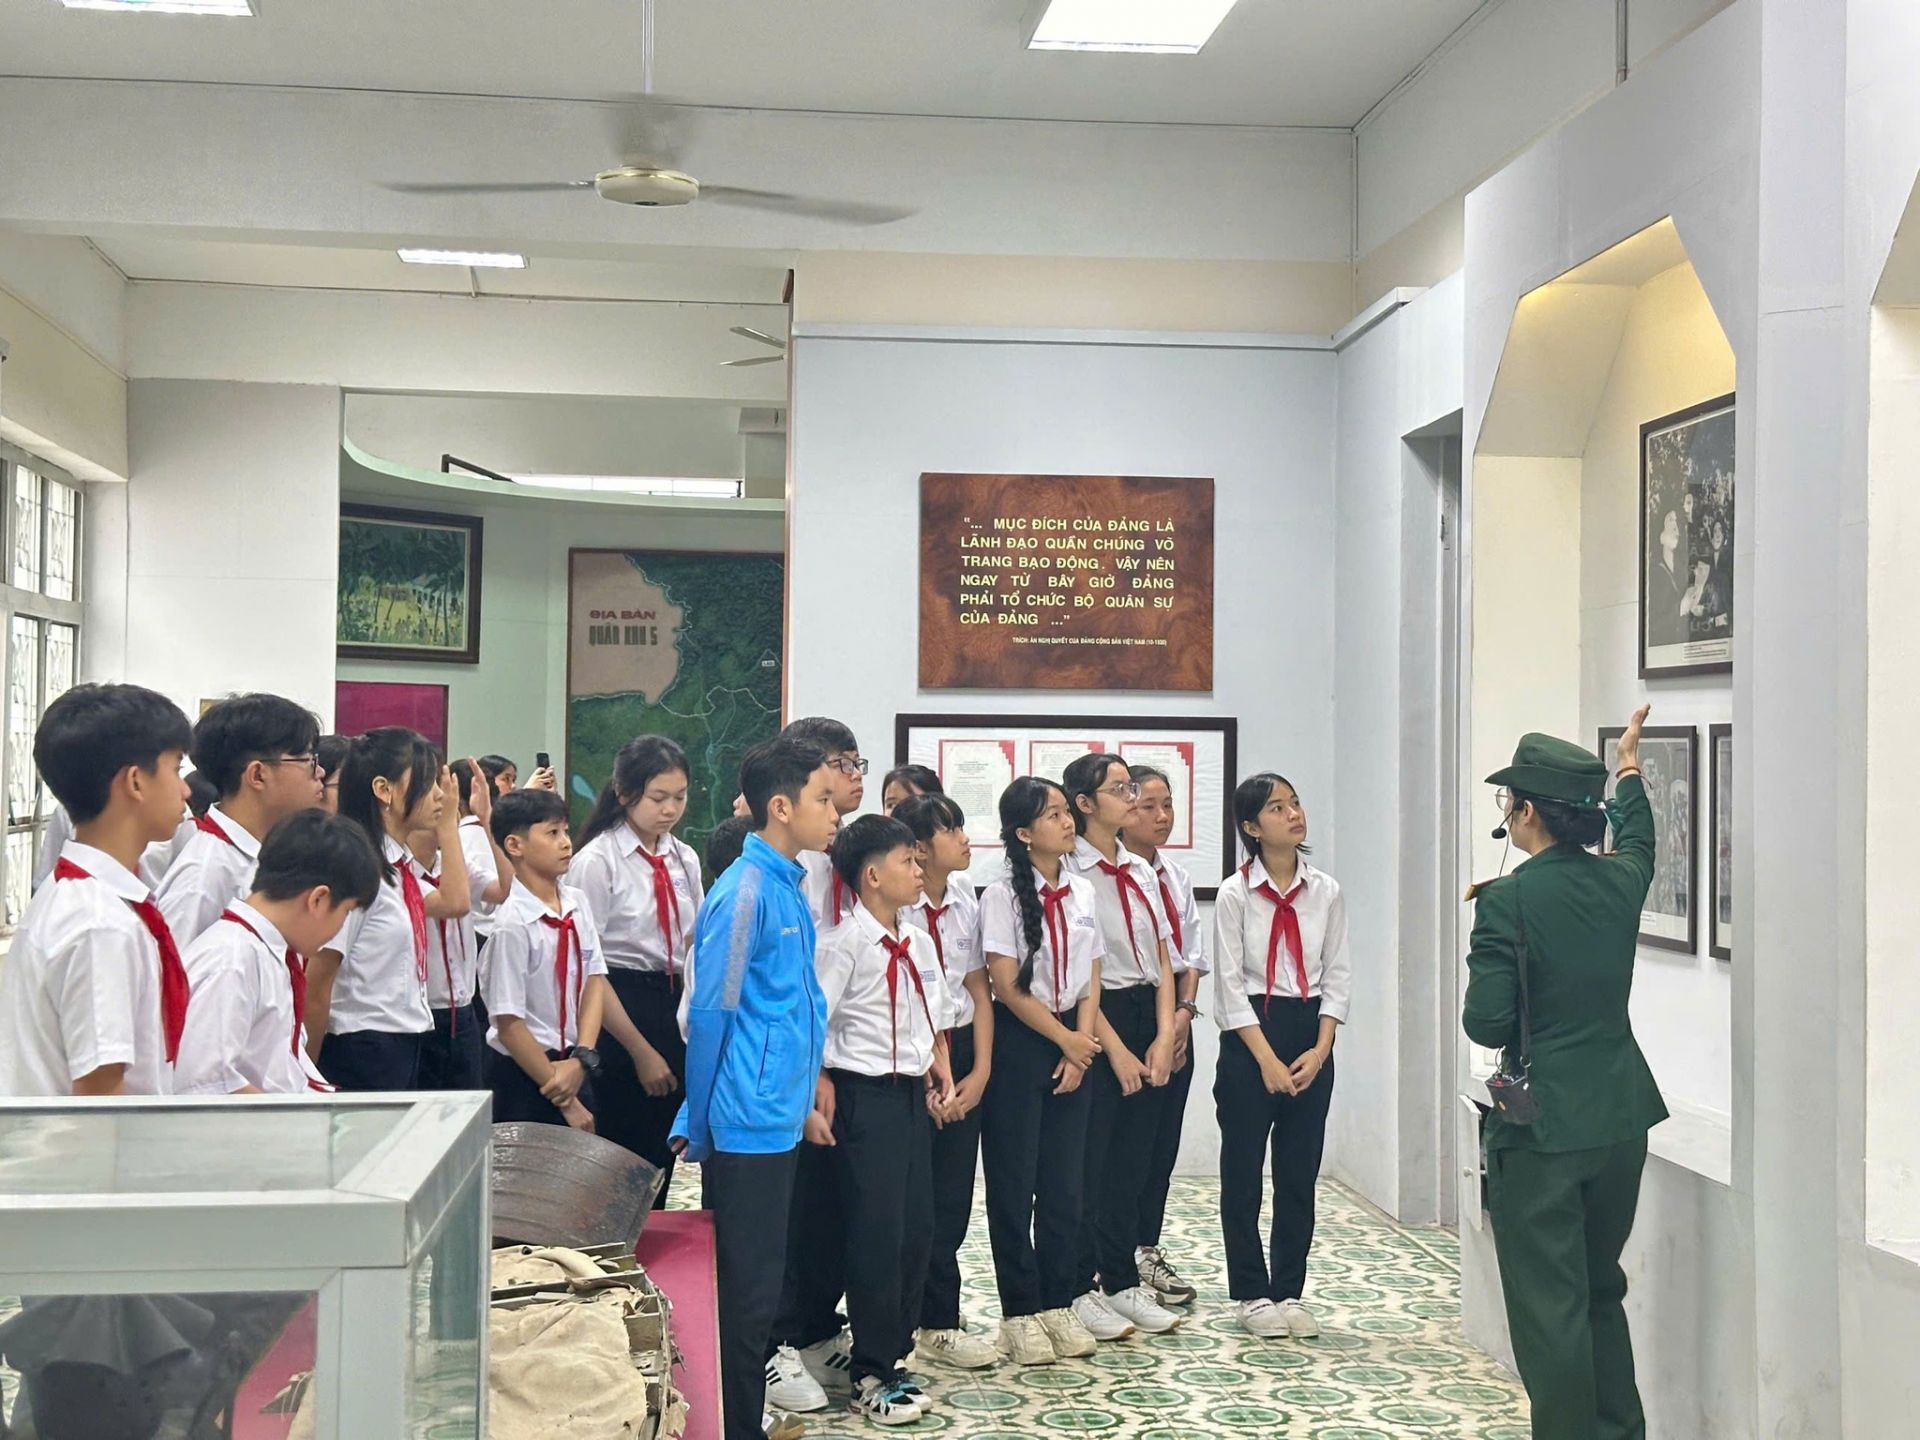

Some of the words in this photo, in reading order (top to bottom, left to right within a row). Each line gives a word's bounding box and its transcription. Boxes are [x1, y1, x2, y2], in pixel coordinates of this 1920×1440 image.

[993, 518, 1027, 532] MỤC
[1032, 516, 1067, 530] ĐÍCH
[1072, 516, 1103, 531] CỦA
[1107, 516, 1150, 532] ĐẢNG
[1156, 517, 1175, 532] LÀ
[960, 533, 1001, 548] LÃNH
[1006, 537, 1039, 550] ĐẠO
[1093, 536, 1145, 550] CHÚNG
[1154, 537, 1175, 551] VÕ
[961, 555, 1013, 567] TRANG
[1018, 557, 1051, 570] BẠO
[1115, 556, 1140, 571] VẬY
[1146, 557, 1175, 571] NÊN
[960, 574, 999, 586] NGAY
[1010, 572, 1031, 587] TỪ
[1048, 574, 1076, 588] BÂY
[1088, 574, 1116, 588] GIỜ
[1132, 573, 1175, 589] ĐẢNG
[960, 590, 994, 605] PHẢI
[1000, 590, 1021, 606] TỔ
[1026, 592, 1067, 607] CHỨC
[1074, 593, 1095, 609] BỘ
[1104, 594, 1145, 608] QUÂN
[1153, 596, 1175, 612] SỰ
[960, 609, 991, 624] CỦA
[998, 609, 1039, 625] ĐẢNG
[650, 626, 658, 646] 5
